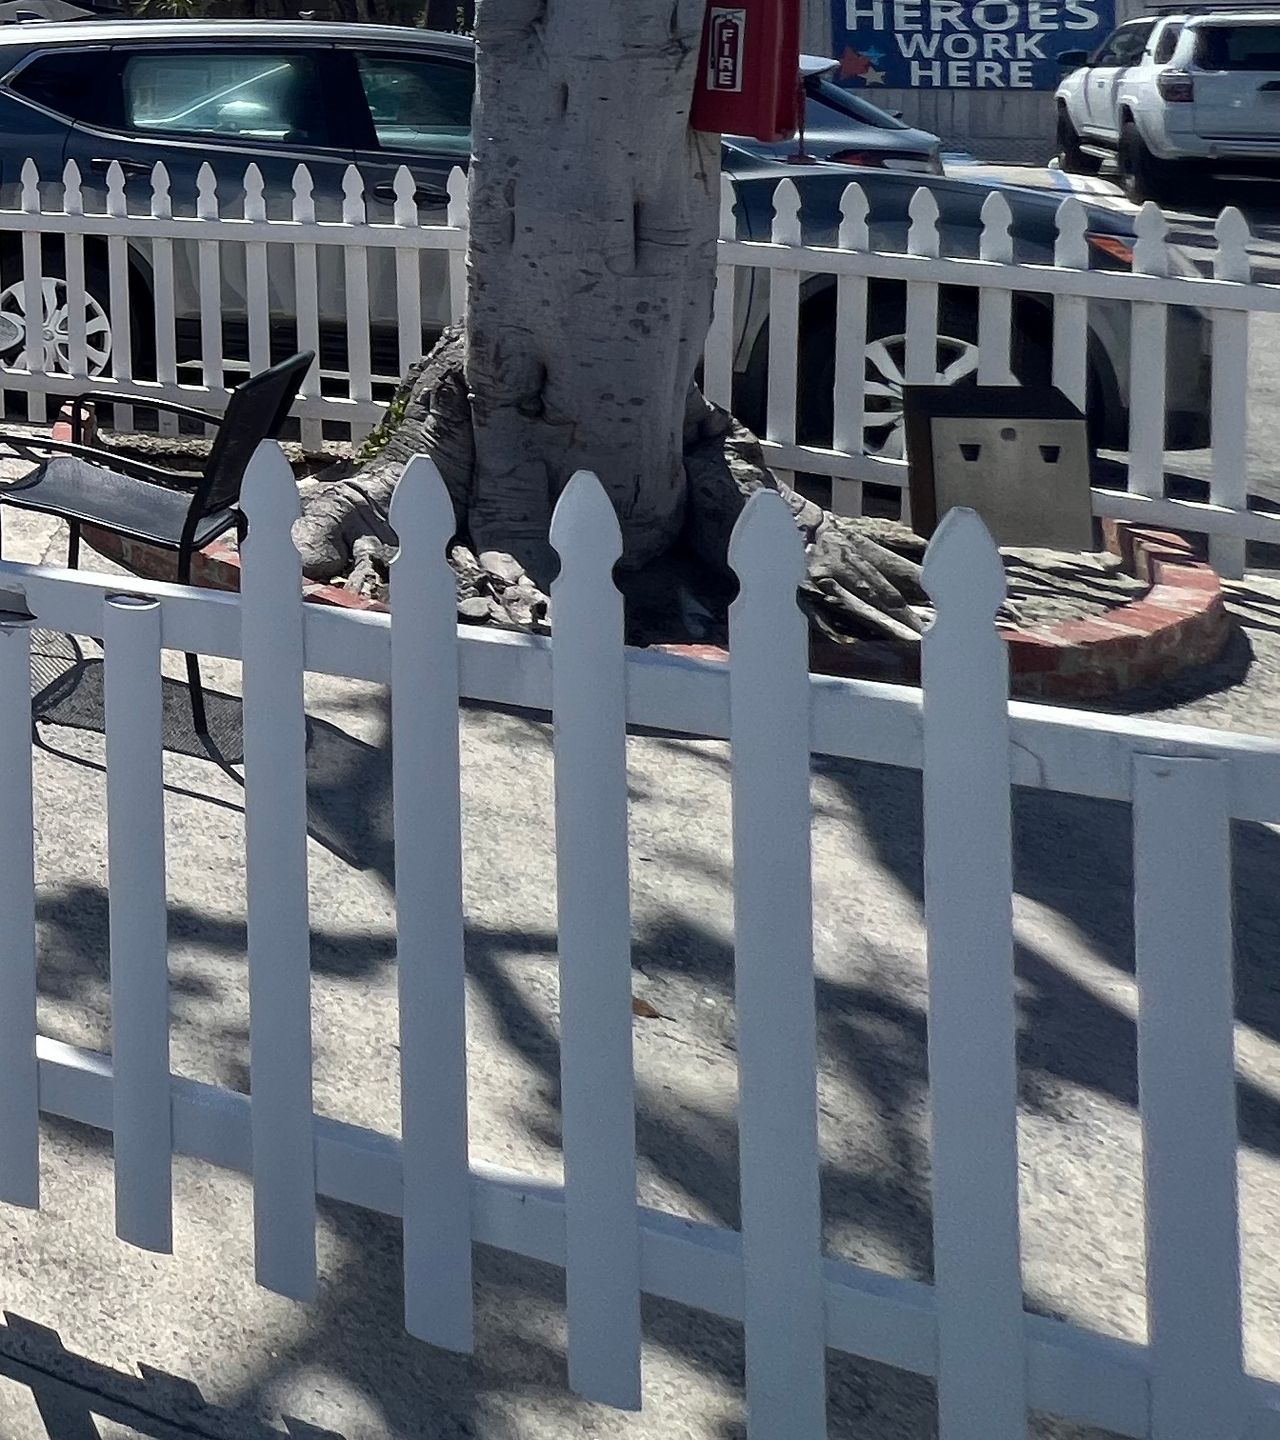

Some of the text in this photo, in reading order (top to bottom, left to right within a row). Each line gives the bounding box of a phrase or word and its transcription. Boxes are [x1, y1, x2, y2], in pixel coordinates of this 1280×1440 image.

[718, 29, 735, 85] FIRE
[894, 32, 1048, 60] WORK
[909, 60, 1034, 88] HERE
